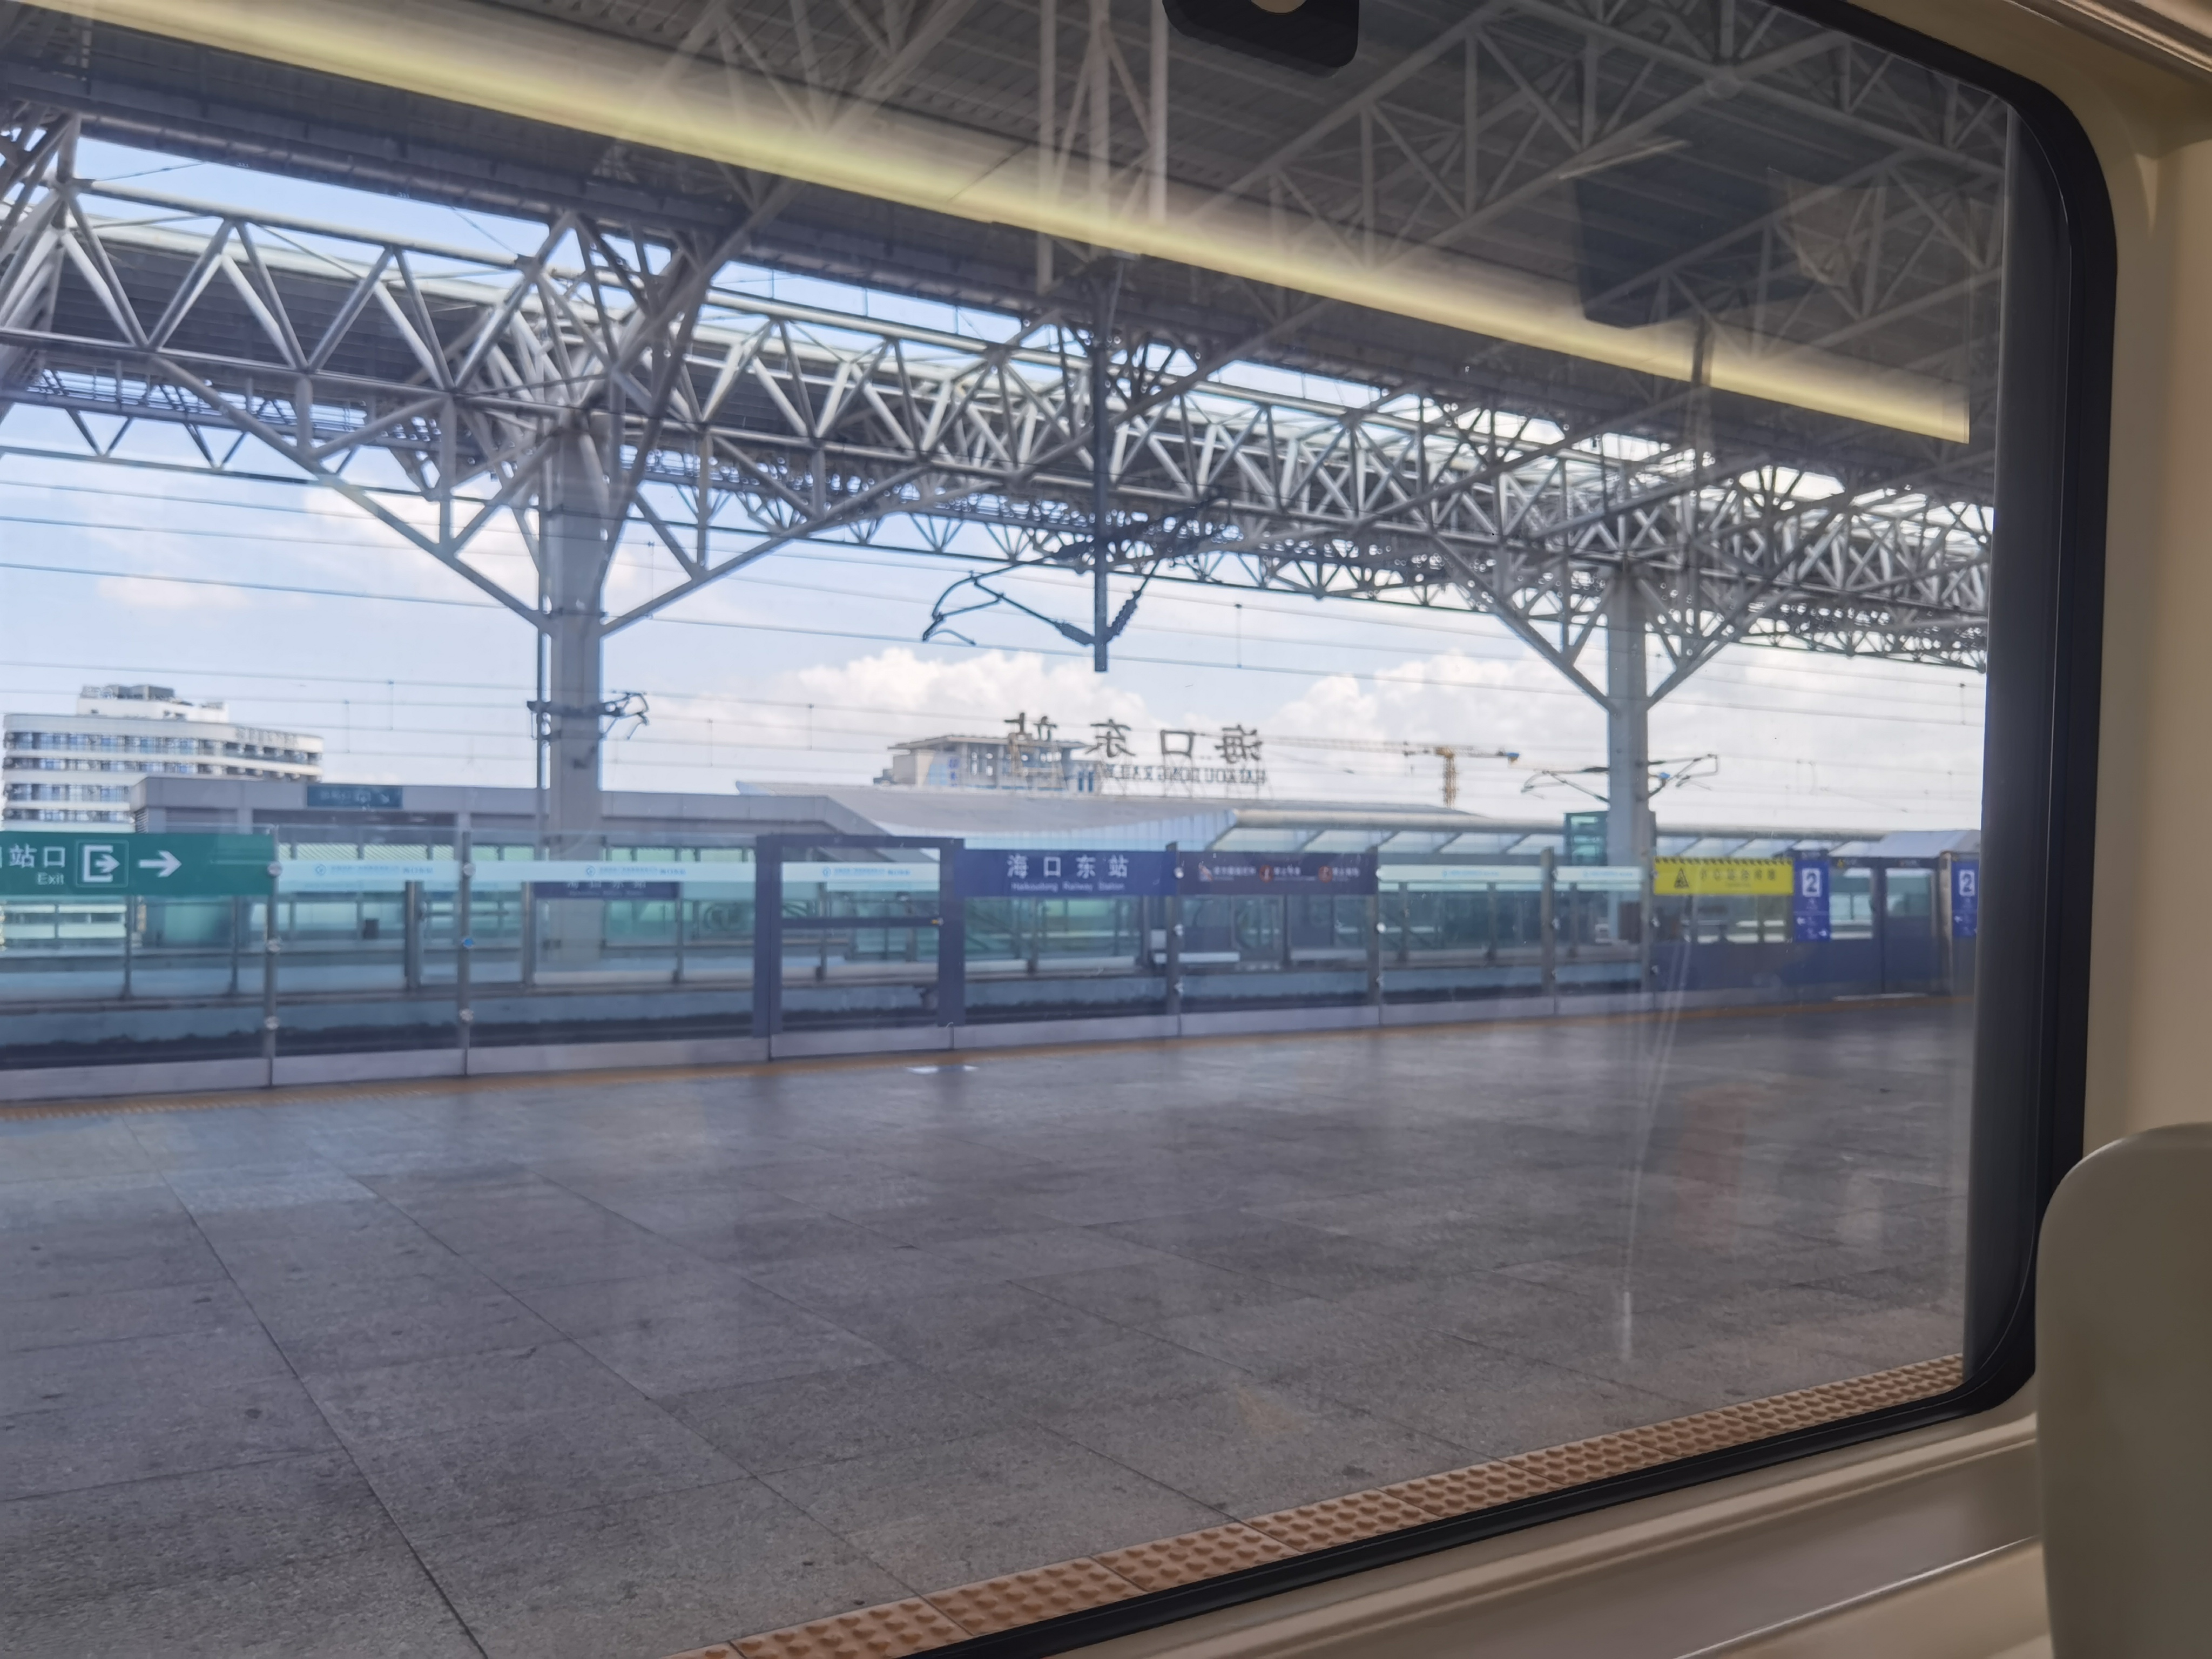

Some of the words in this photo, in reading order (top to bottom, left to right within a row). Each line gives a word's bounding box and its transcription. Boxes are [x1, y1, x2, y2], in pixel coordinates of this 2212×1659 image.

[0, 843, 65, 868] 站口
[1006, 853, 1129, 879] 海口东站
[37, 872, 64, 885] Exit
[1062, 881, 1094, 892] Railway
[1098, 880, 1125, 891] Station
[1806, 872, 1817, 893] 2
[1962, 873, 1972, 892] 2
